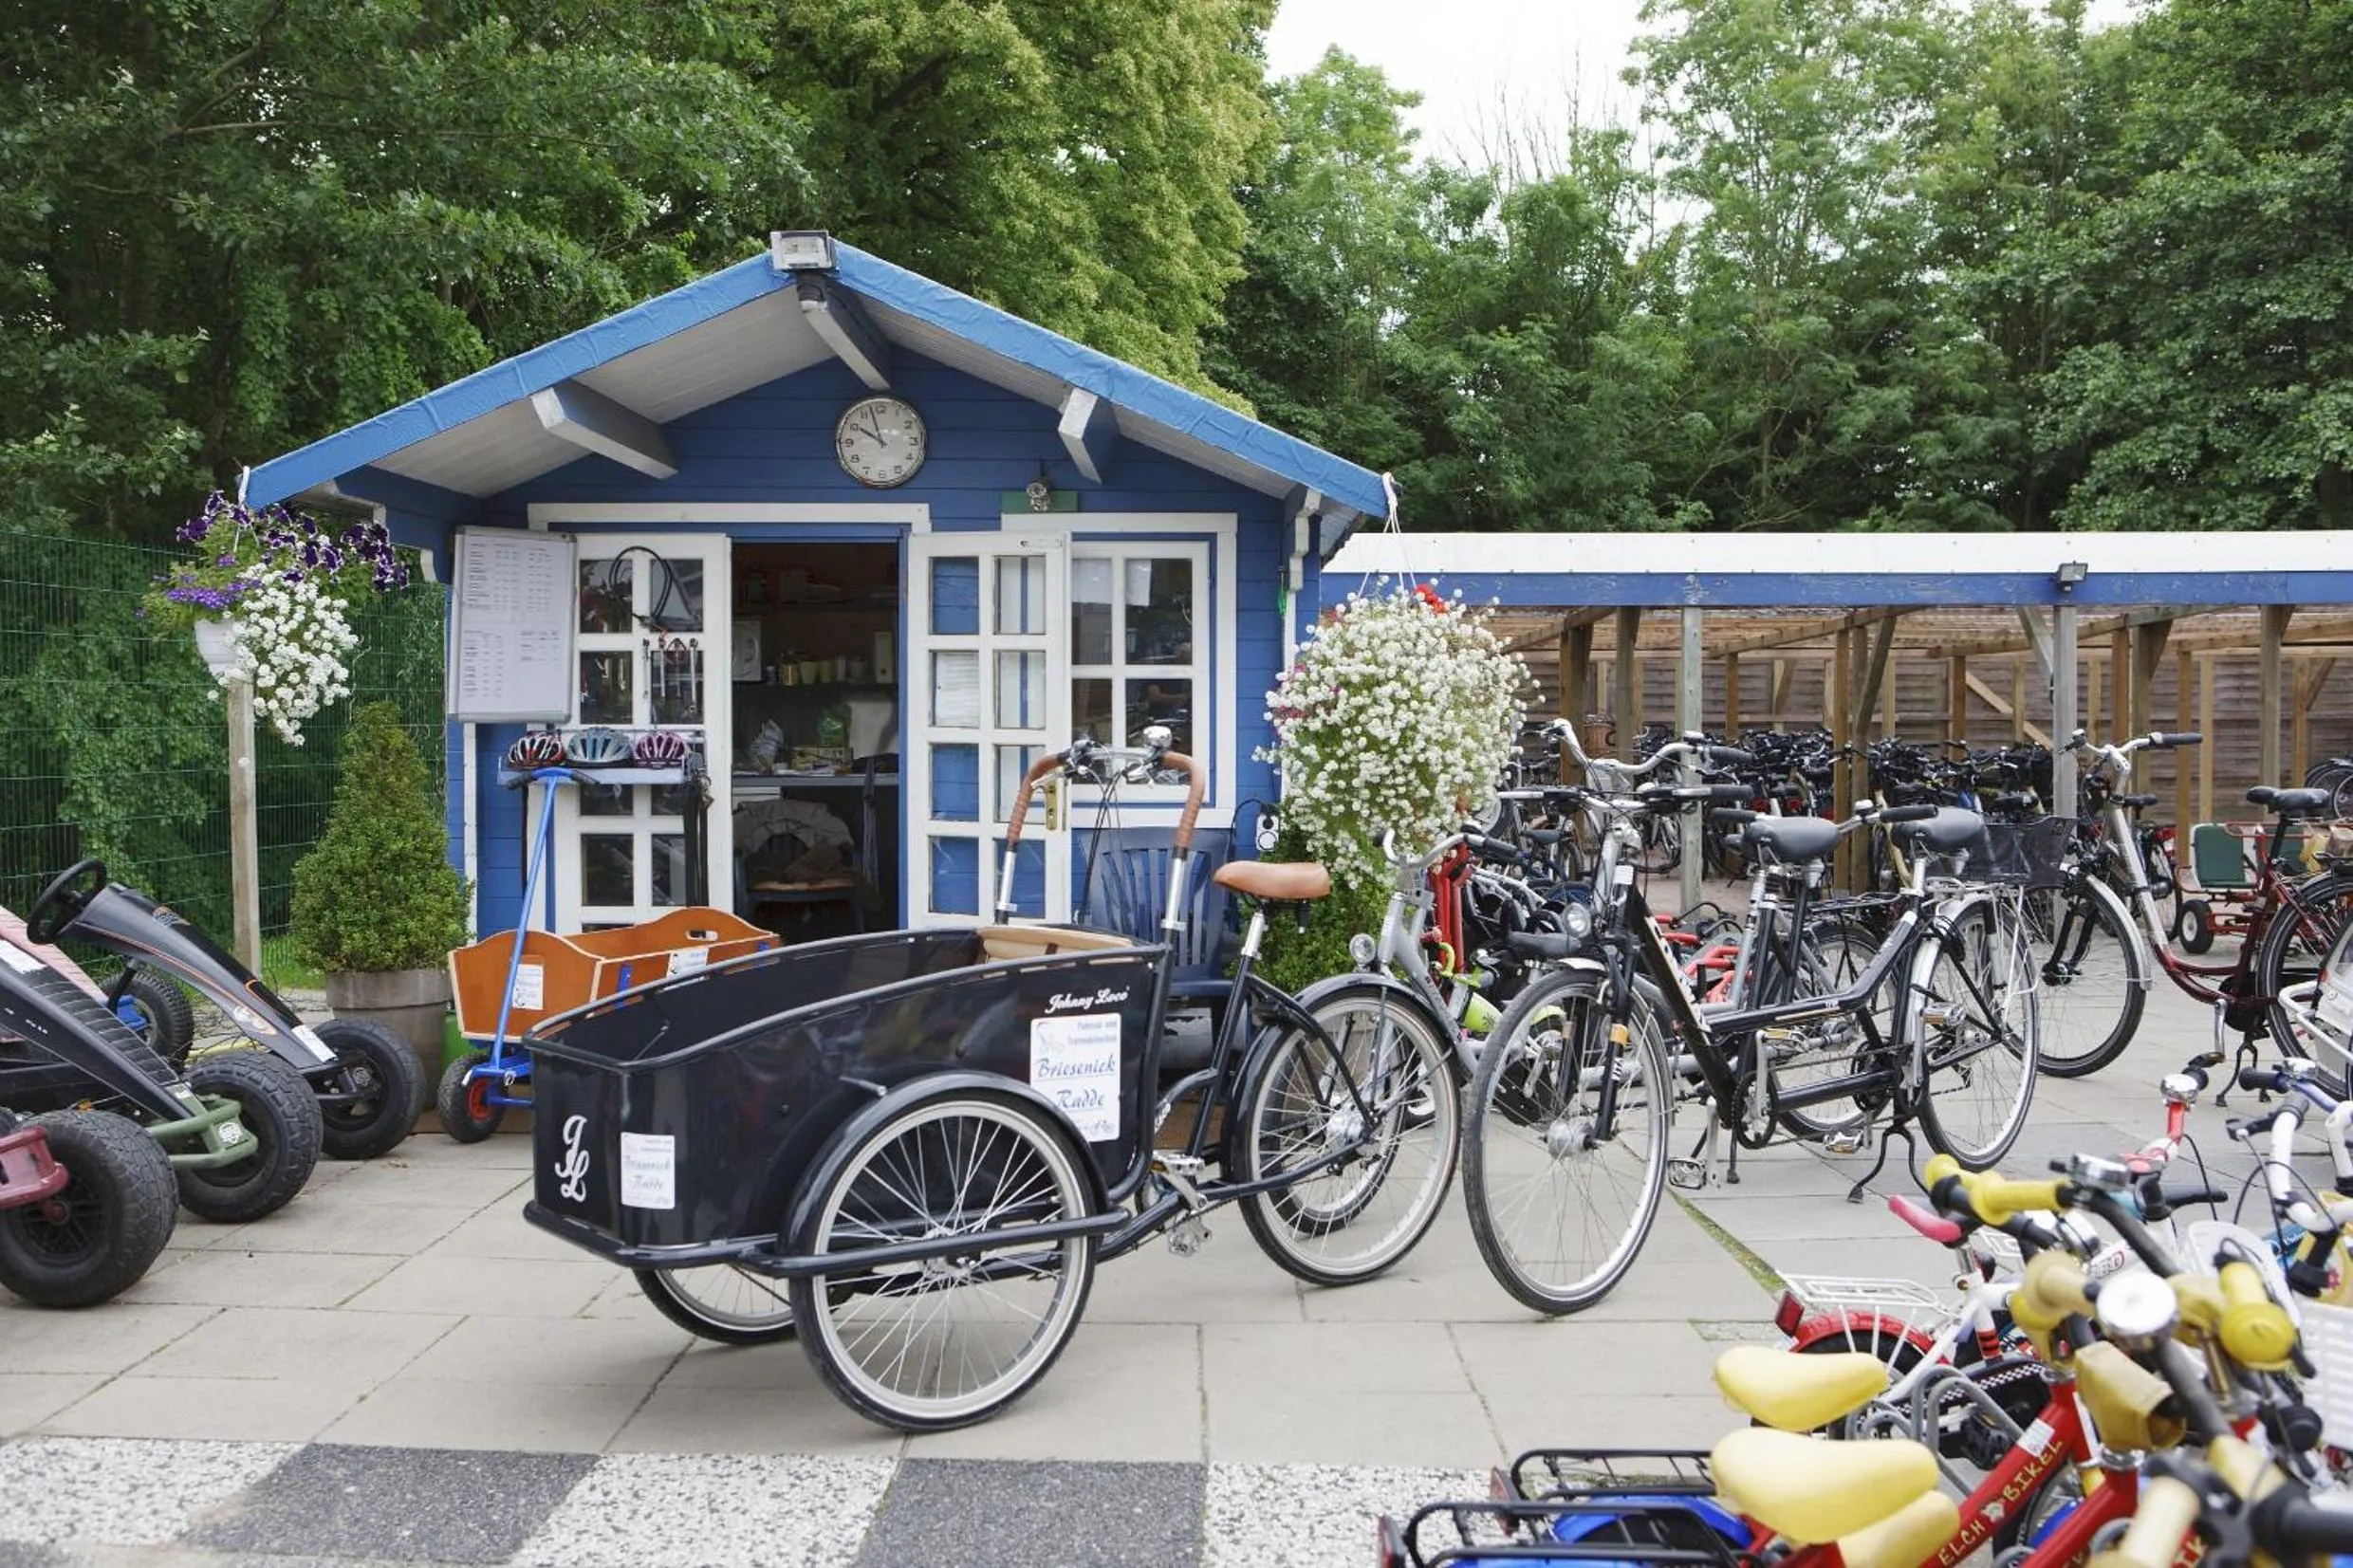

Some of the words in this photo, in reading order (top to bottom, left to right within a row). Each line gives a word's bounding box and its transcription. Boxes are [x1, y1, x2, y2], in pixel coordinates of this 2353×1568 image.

[844, 438, 854, 448] 9
[862, 466, 871, 475] 7
[894, 465, 903, 474] 5
[878, 470, 887, 479] 6
[1045, 993, 1093, 1014] Johnny
[1094, 987, 1128, 1005] Loco
[1938, 1520, 1985, 1565] ELCH
